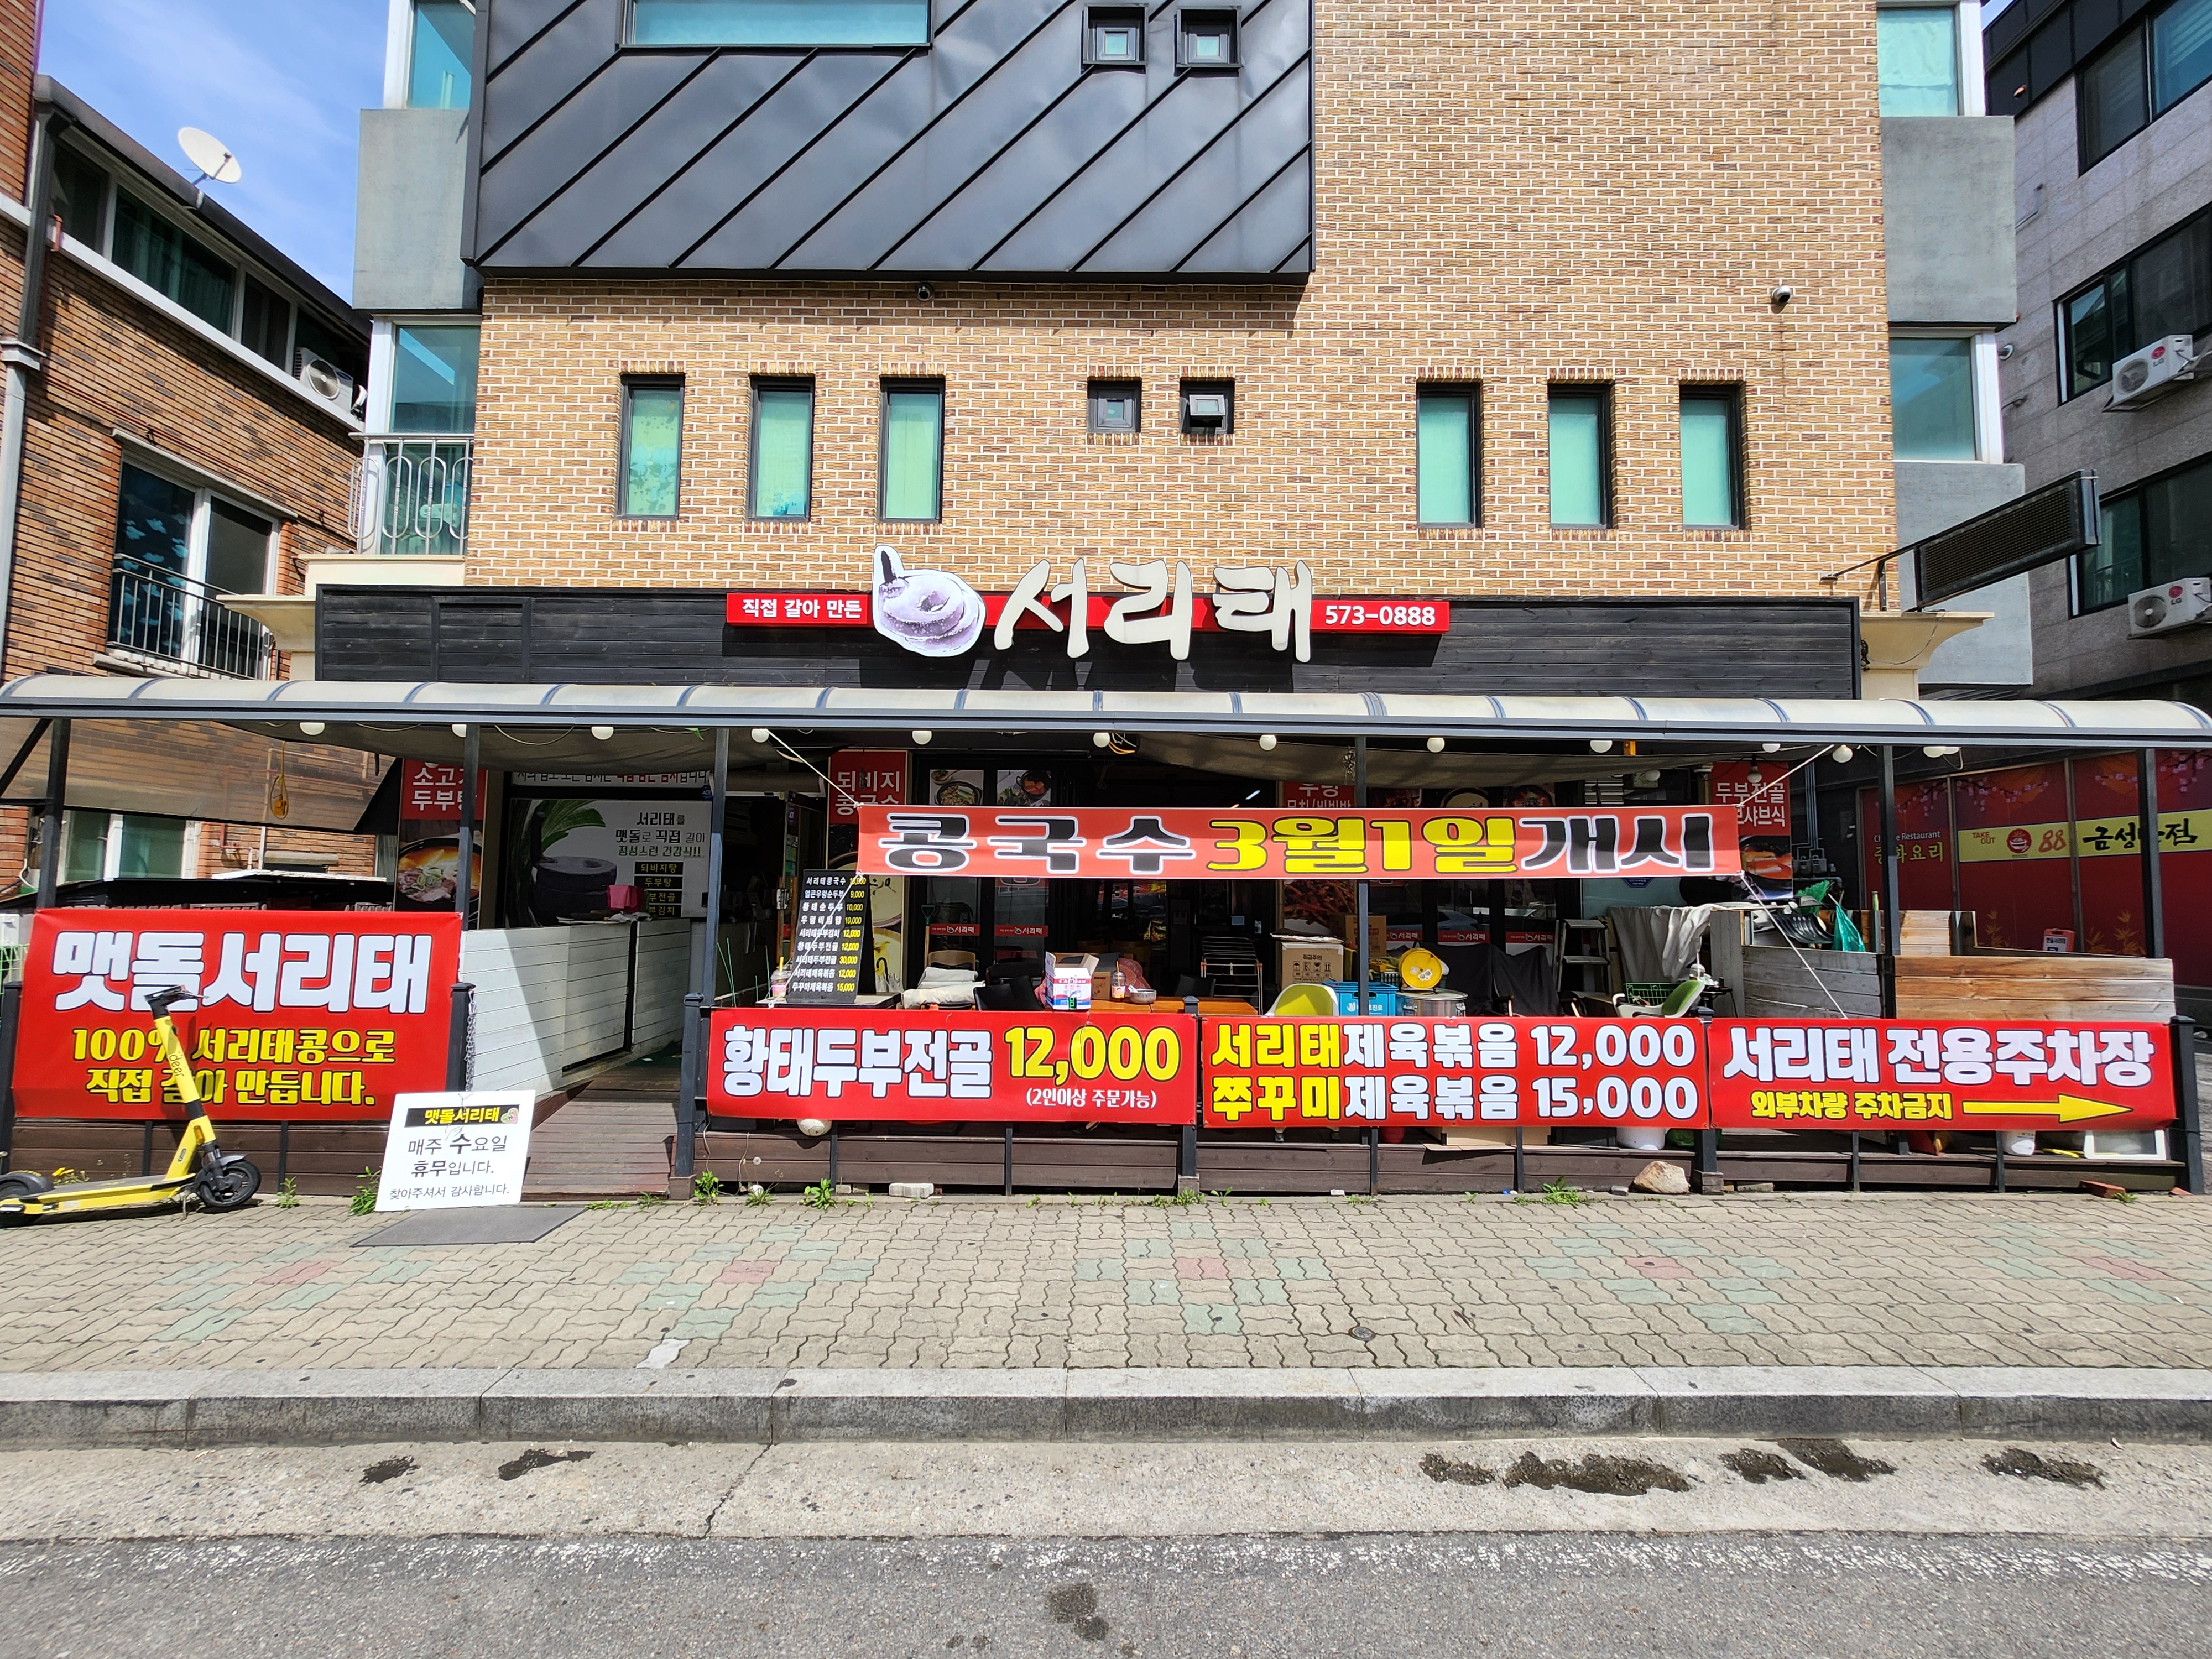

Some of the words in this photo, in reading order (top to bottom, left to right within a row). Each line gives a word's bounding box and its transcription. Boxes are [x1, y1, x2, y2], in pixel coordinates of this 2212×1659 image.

[2153, 358, 2164, 367] LG
[743, 599, 777, 618] 직접
[784, 599, 820, 619] 갈아
[826, 599, 862, 618] 만든
[994, 558, 1312, 661] 서리태
[1326, 606, 1435, 625] 573-0888
[837, 771, 900, 792] 되비지
[1715, 782, 1785, 804] 두부전골
[637, 812, 685, 825] 서리태를
[1738, 806, 1785, 827] 샤브식
[616, 830, 650, 843] 맷돌로
[656, 830, 680, 843] 직접
[686, 832, 705, 843] 갈아
[1901, 831, 1940, 840] Restaurant
[2038, 830, 2066, 853] 88
[2083, 818, 2198, 850] 금성점
[619, 846, 658, 857] 정성스런
[663, 846, 701, 857] 건강식!!
[641, 863, 677, 874] 되비지탕
[644, 878, 672, 887] 두부탕
[649, 893, 676, 902] 부전골
[850, 890, 865, 899] 9,000
[649, 906, 675, 916] 부김치
[845, 916, 862, 925] 10,000
[843, 929, 860, 938] 12,000
[841, 942, 859, 952] 12,000
[839, 956, 858, 965] 30,000
[53, 931, 433, 1014] 맷돌서리태
[838, 969, 856, 978] 12,000
[837, 983, 855, 992] 15,000
[191, 1027, 395, 1064] 서리태콩으로
[1531, 1024, 1696, 1071] 12,000
[169, 1054, 185, 1077] deer
[723, 1024, 994, 1098] 황태두부전골
[1003, 1026, 1181, 1087] 12,000
[1724, 1026, 1881, 1084] 서리태
[1886, 1027, 2154, 1088] 전용주차장
[86, 1068, 153, 1103] 직접
[235, 1070, 375, 1105] 만듭니다.
[1026, 1087, 1087, 1107] (2인이상
[1092, 1089, 1157, 1109] 주문가능)
[1532, 1076, 1699, 1121] 15,000
[1751, 1091, 1849, 1119] 외부차량
[1855, 1092, 1952, 1120] 주차금지
[425, 1107, 500, 1124] 맷돌서리태
[408, 1139, 442, 1155] 매주
[449, 1134, 507, 1155] 수요일
[411, 1160, 494, 1178] 휴무입니다.
[390, 1186, 446, 1200] 찾아주셔서
[451, 1183, 509, 1197] 감사합니다.
